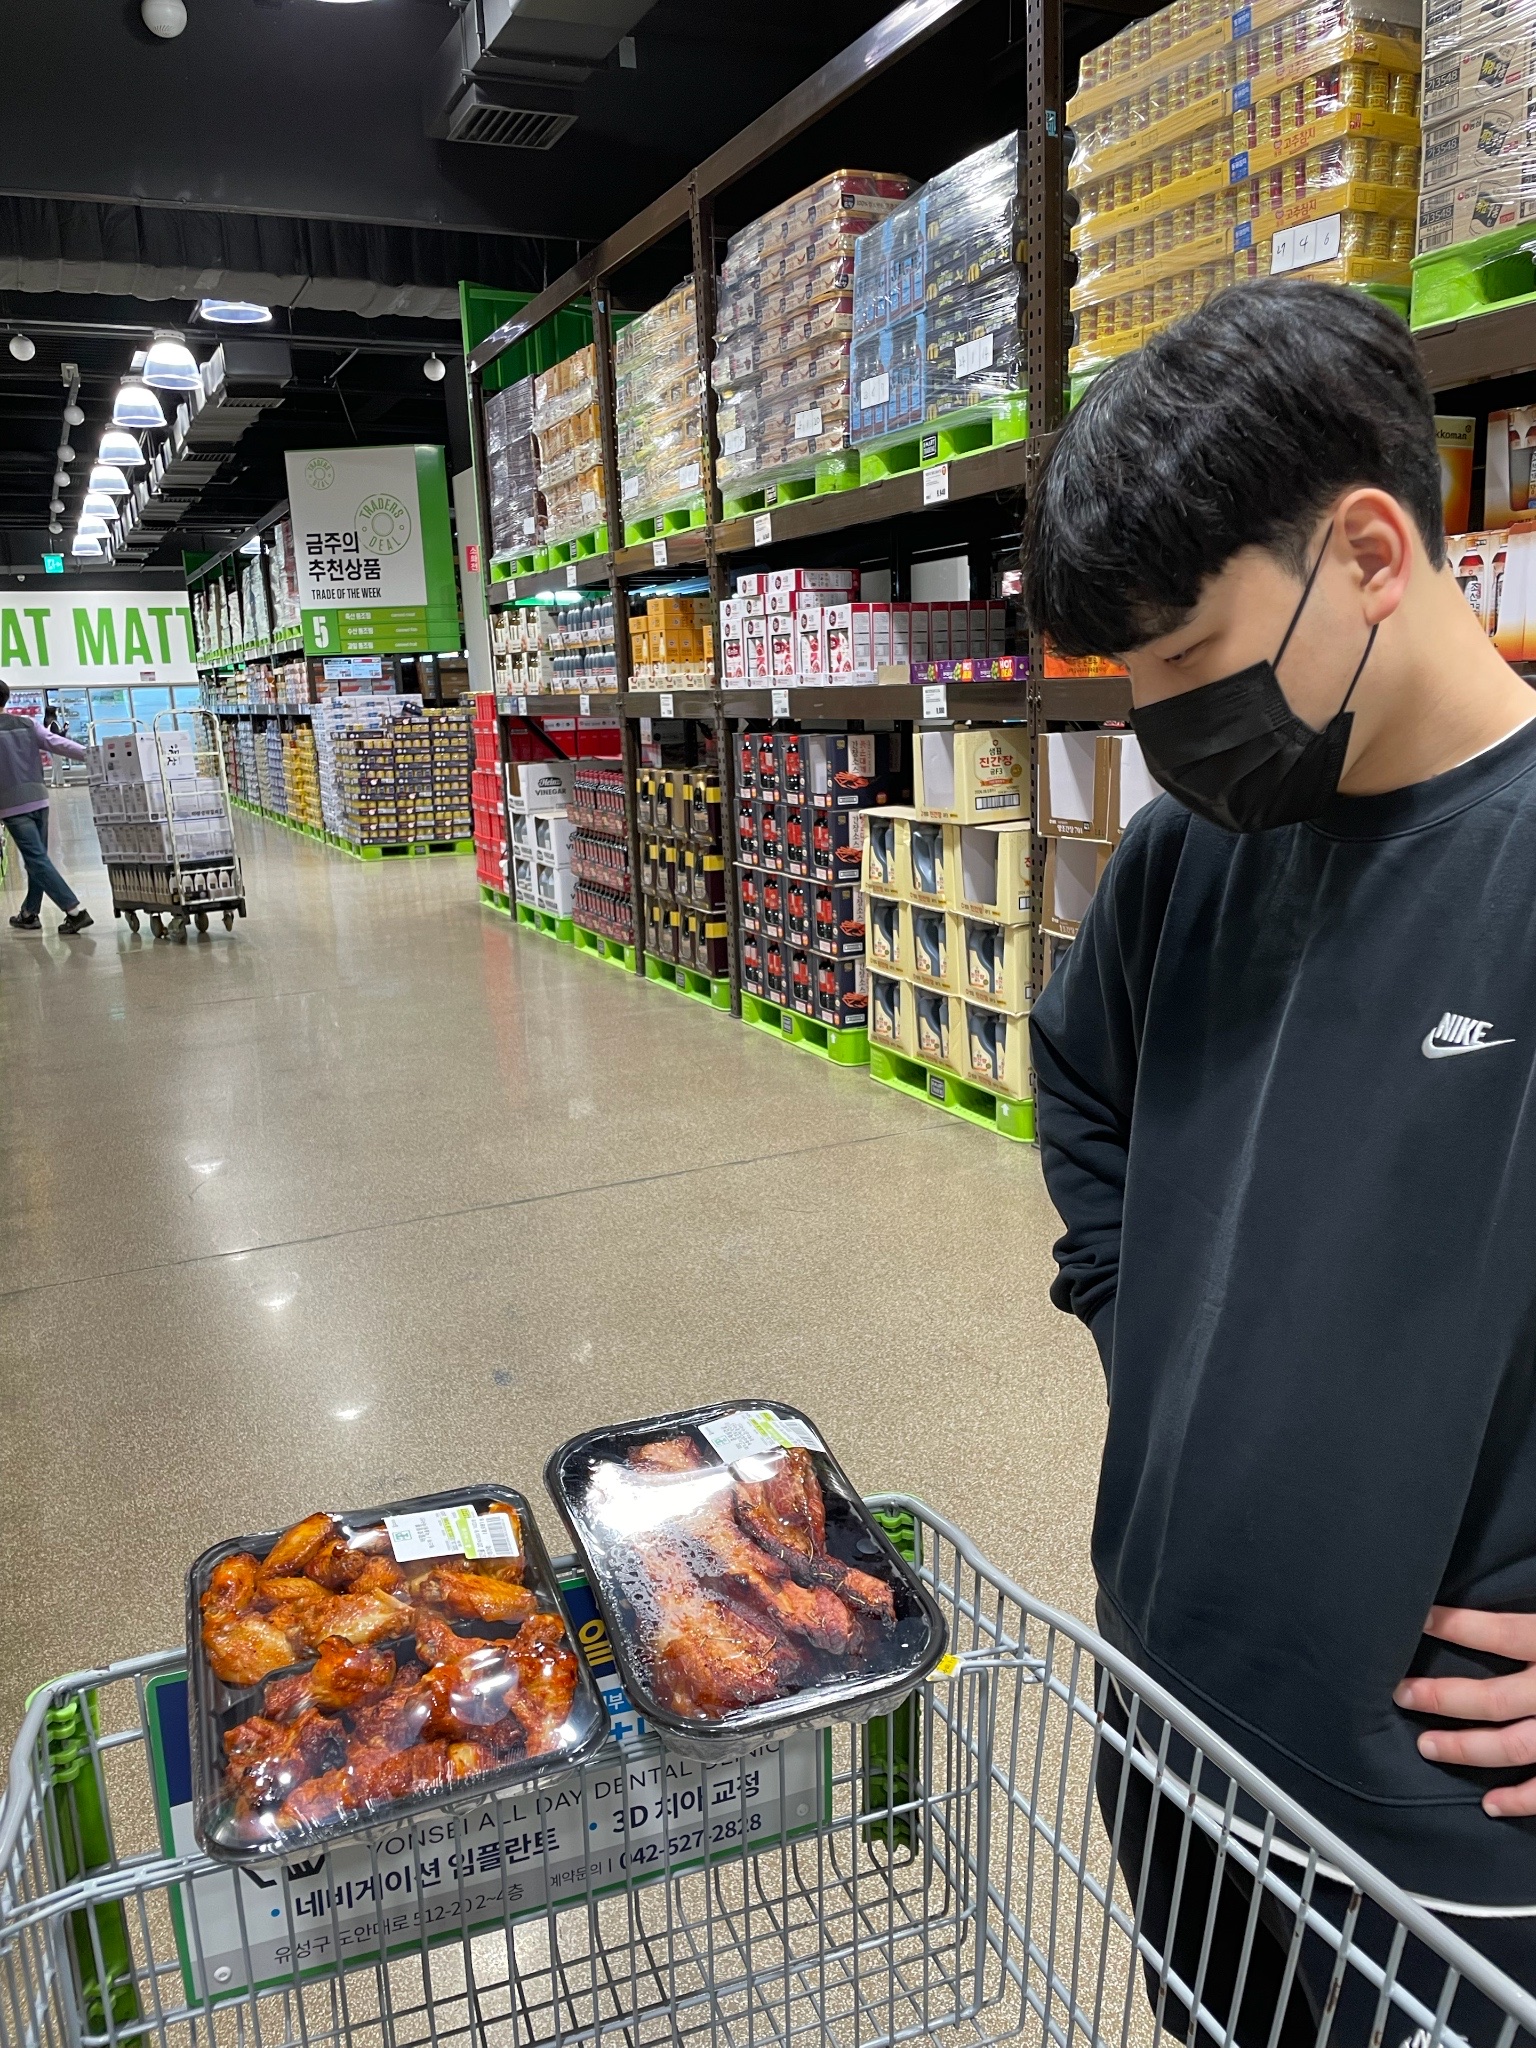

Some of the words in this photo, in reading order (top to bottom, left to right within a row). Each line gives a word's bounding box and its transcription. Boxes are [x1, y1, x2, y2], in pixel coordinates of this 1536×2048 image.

[1422, 206, 1452, 224] 가3548
[359, 497, 404, 519] TRADERS
[305, 531, 360, 555] 금주의
[369, 536, 401, 551] DEAL
[308, 558, 381, 582] 추천상품
[311, 589, 336, 600] TRADE
[336, 588, 347, 600] OF
[346, 588, 361, 599] THE
[361, 587, 382, 599] WEEK
[1, 608, 51, 667] AT
[72, 607, 196, 666] MATT
[312, 615, 330, 649] 5
[1000, 659, 1013, 669] HOT
[979, 755, 1014, 768] 진간장
[535, 788, 567, 796] VINEGAR
[1434, 1011, 1494, 1046] NIKE
[479, 1804, 526, 1831] AL
[536, 1790, 582, 1816] DAY
[595, 1761, 693, 1800] DENTAL
[295, 1856, 442, 1918] 네비게이션
[448, 1827, 560, 1877] 임플란트
[612, 1805, 649, 1834] 3D
[655, 1786, 704, 1819] 치아
[710, 1770, 760, 1806] 교정
[619, 1813, 762, 1870] 042-527-2828
[274, 1936, 331, 1965] 유성구
[338, 1914, 410, 1947] 도안대로
